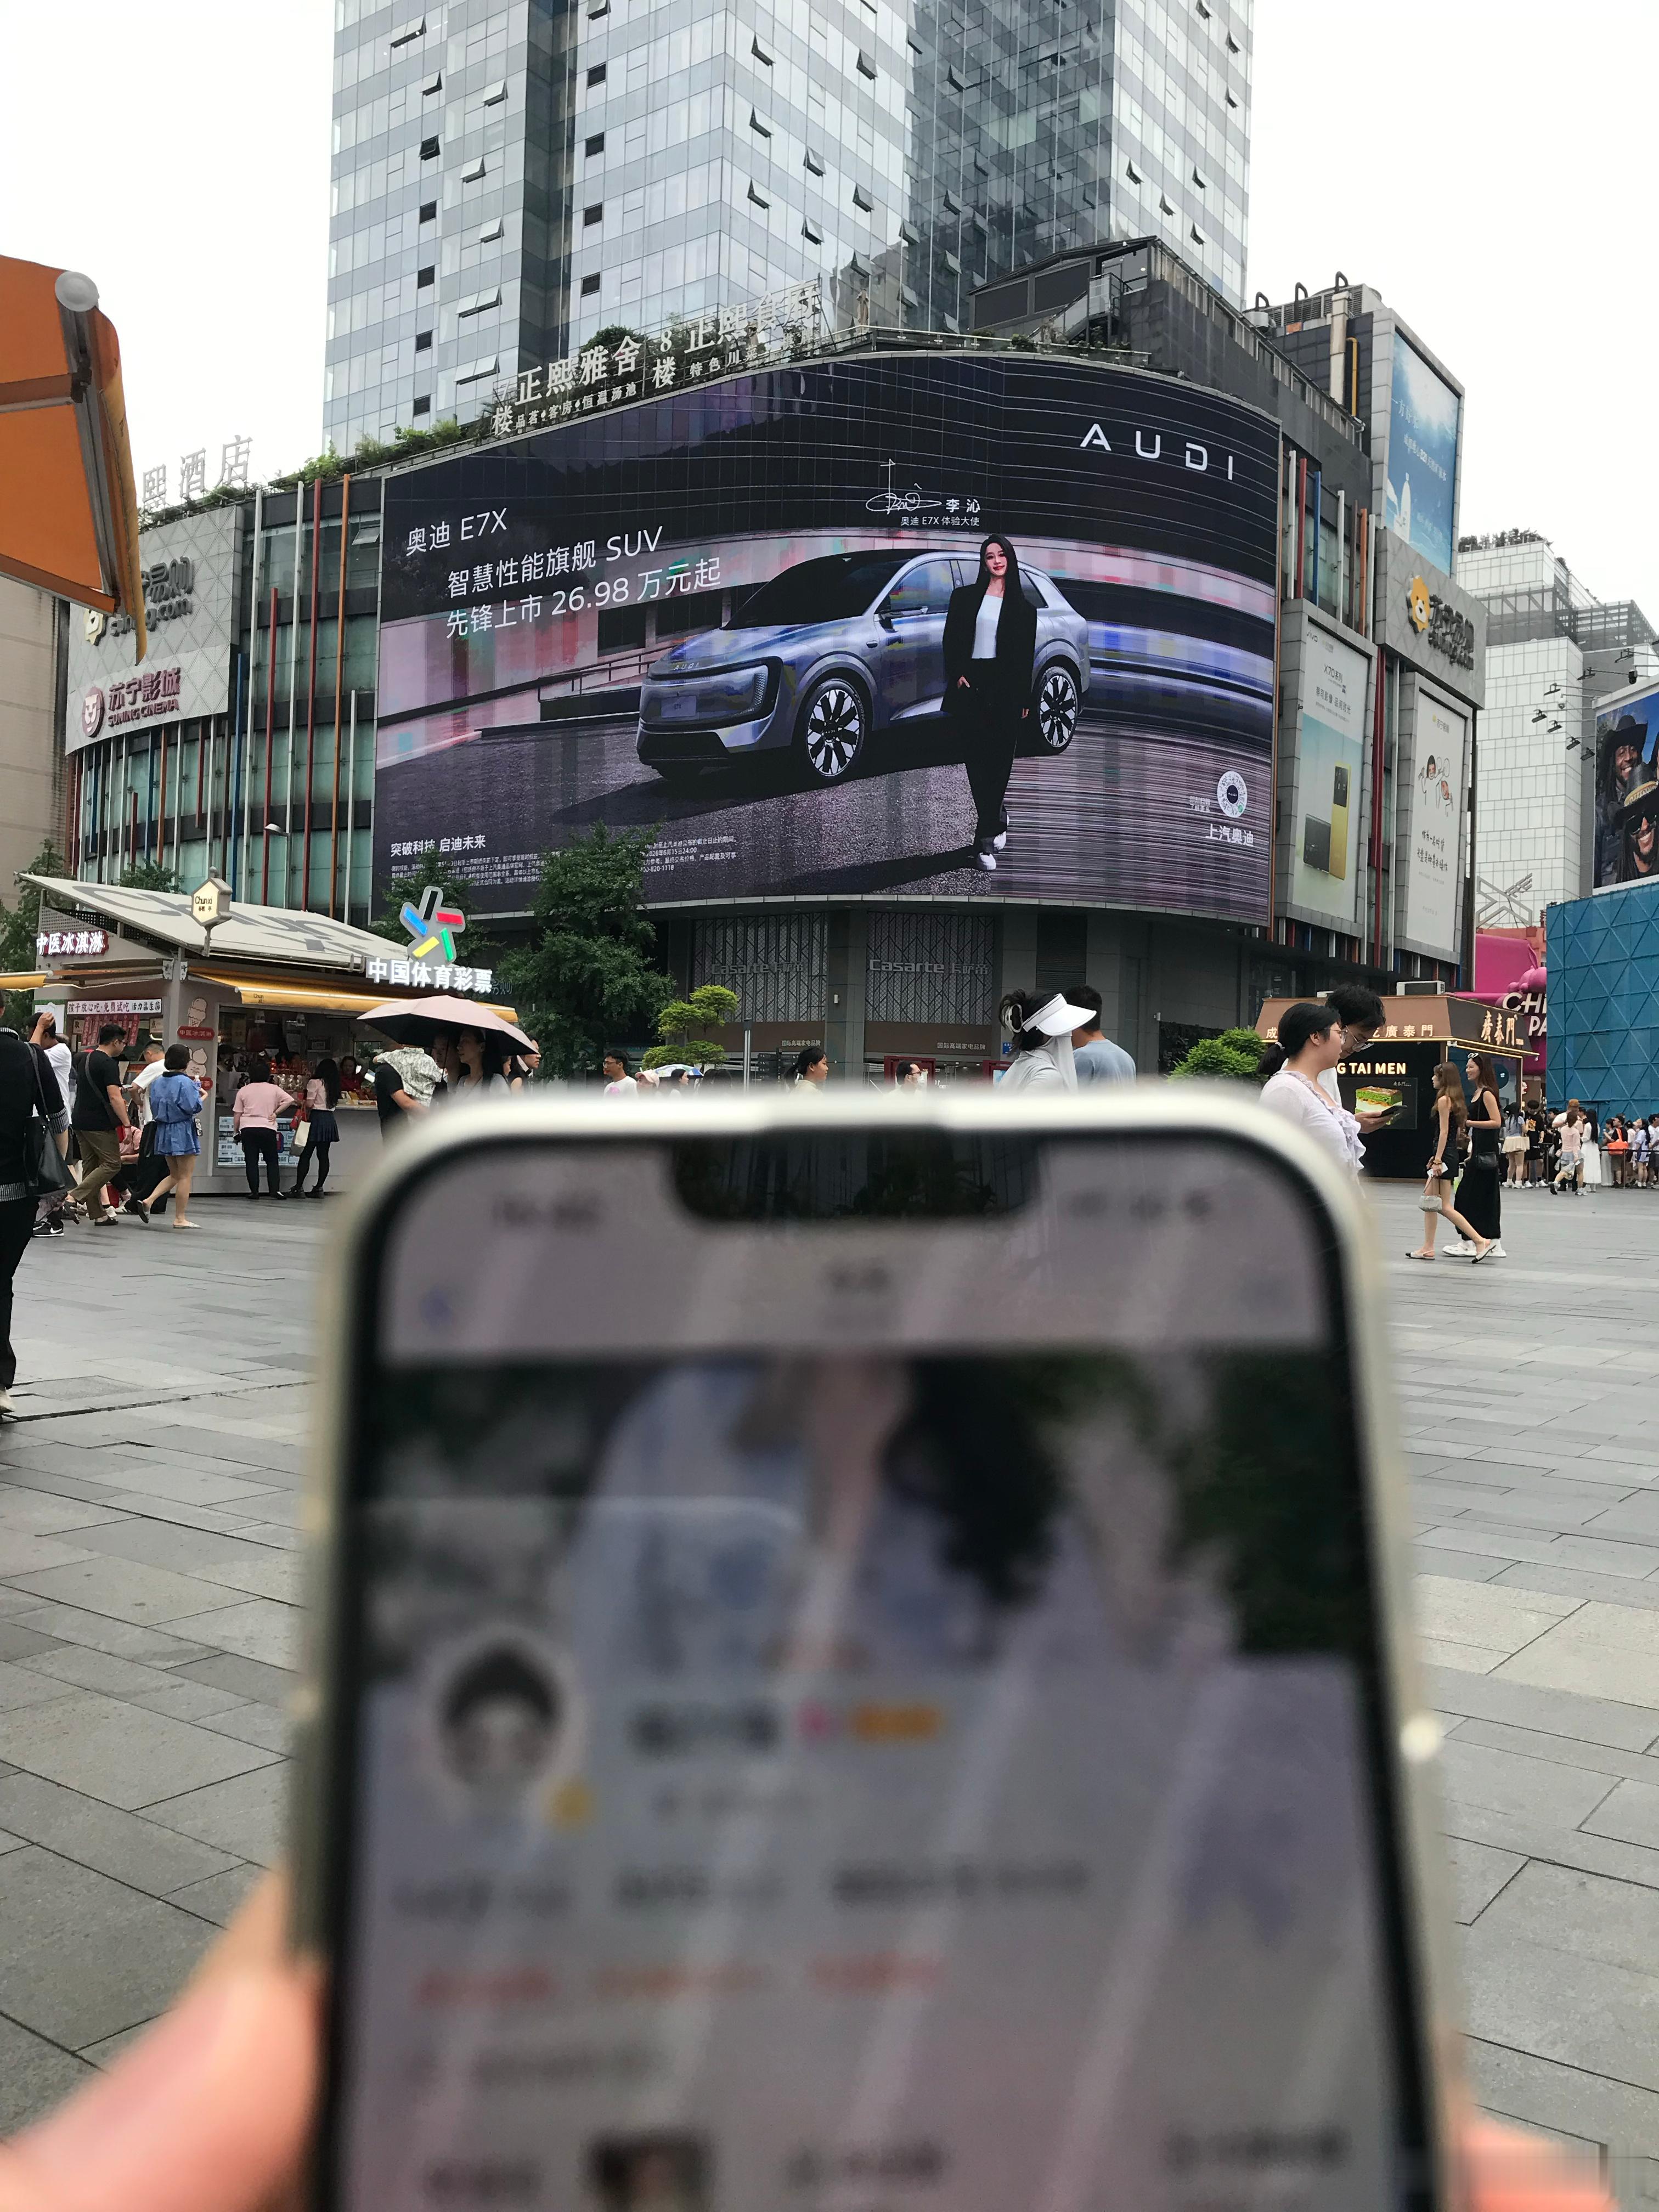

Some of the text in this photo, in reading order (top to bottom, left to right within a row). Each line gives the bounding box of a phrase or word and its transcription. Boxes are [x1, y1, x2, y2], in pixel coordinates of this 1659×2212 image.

[515, 335, 643, 406] 正熙雅舍
[1079, 423, 1234, 481] AUDI
[406, 507, 507, 557] 奥迪 E7X
[900, 516, 980, 527] 奥迪 E7X 体验大使
[447, 526, 663, 599] 智慧性能旗舰 SUV
[445, 556, 721, 640] 先锋上市 26.98 万元起
[108, 667, 182, 712] 苏宁影城
[108, 698, 179, 727] SUNING CINEMA
[391, 834, 487, 857] 突破科技 启迪未来
[1205, 823, 1255, 847] 上汽奥迪
[36, 930, 106, 956] 中医冰淇淋
[368, 956, 493, 994] 中国体育彩票
[869, 959, 945, 974] Casarte
[936, 1042, 986, 1051] 国际高端家电品牌
[1348, 1062, 1372, 1075] TAI
[1375, 1062, 1406, 1075] MEN
